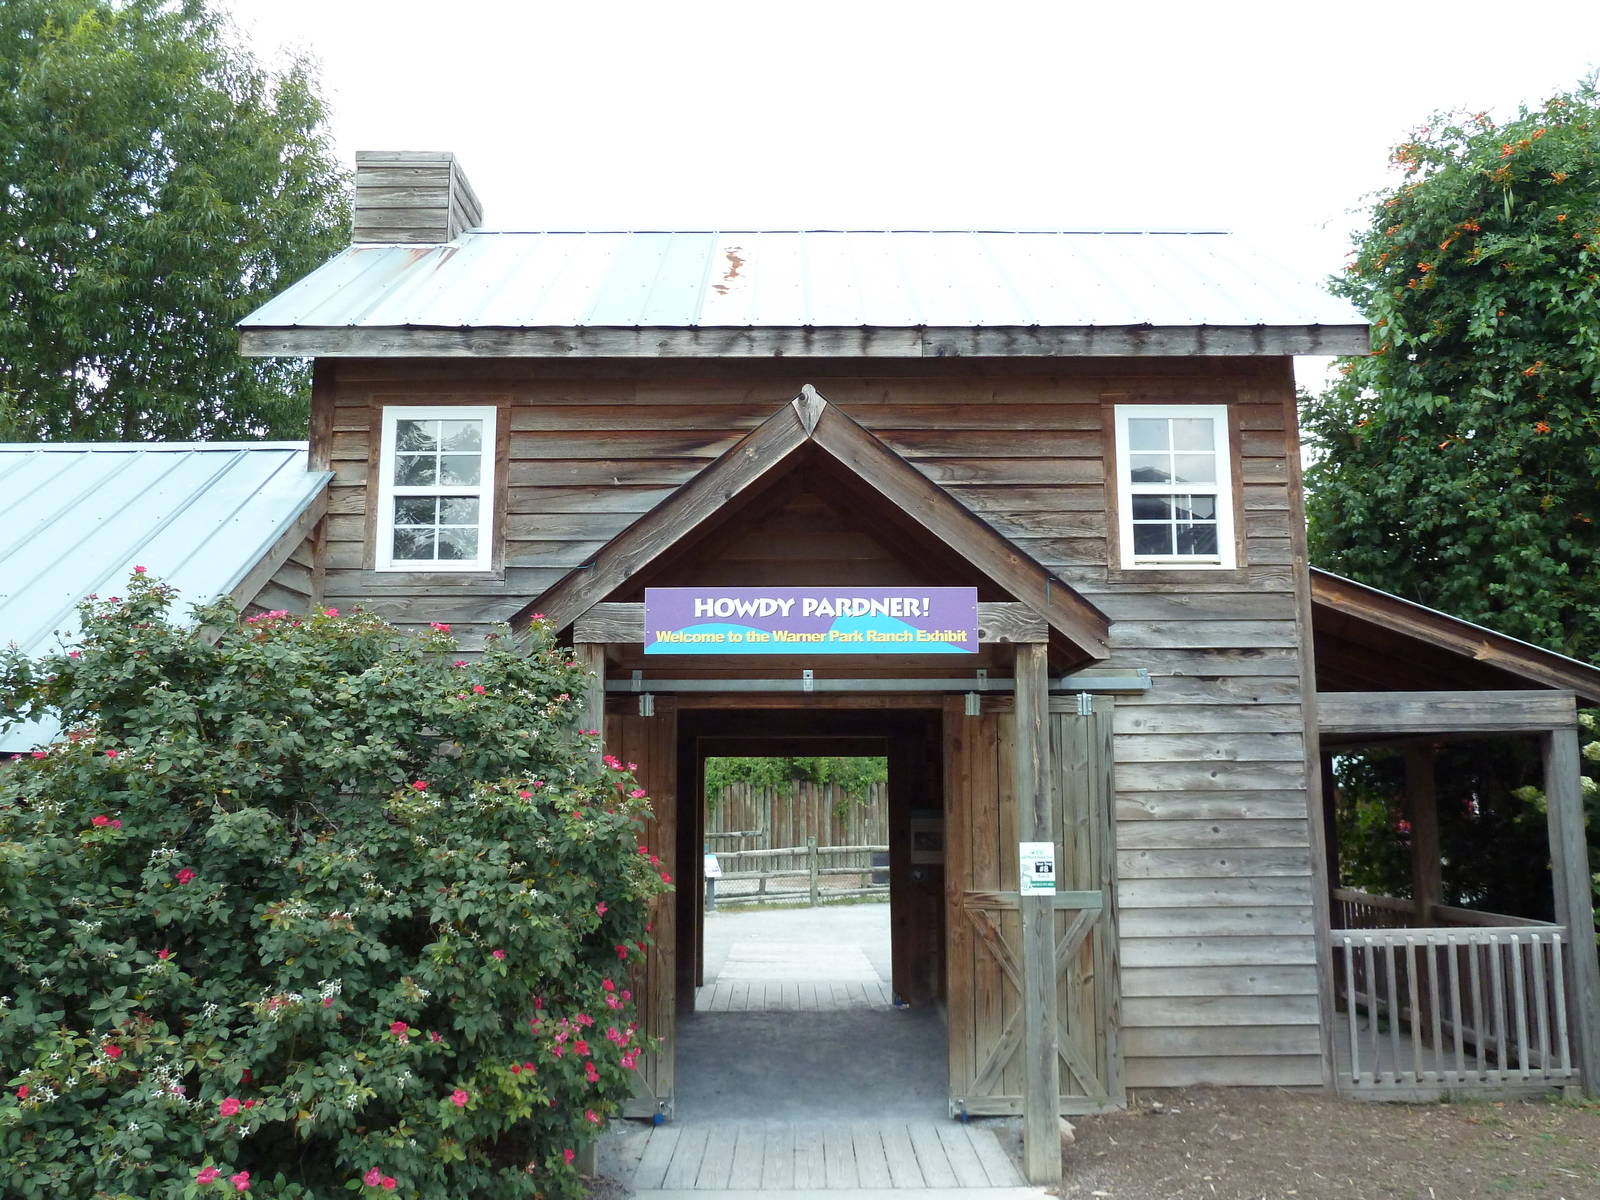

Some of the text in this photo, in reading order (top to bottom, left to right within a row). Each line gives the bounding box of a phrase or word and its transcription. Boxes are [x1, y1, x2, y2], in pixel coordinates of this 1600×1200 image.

[694, 598, 930, 617] HOWDY PARDNER!
[656, 630, 967, 643] Welcome to the Warner Park Ranch Exhibit
